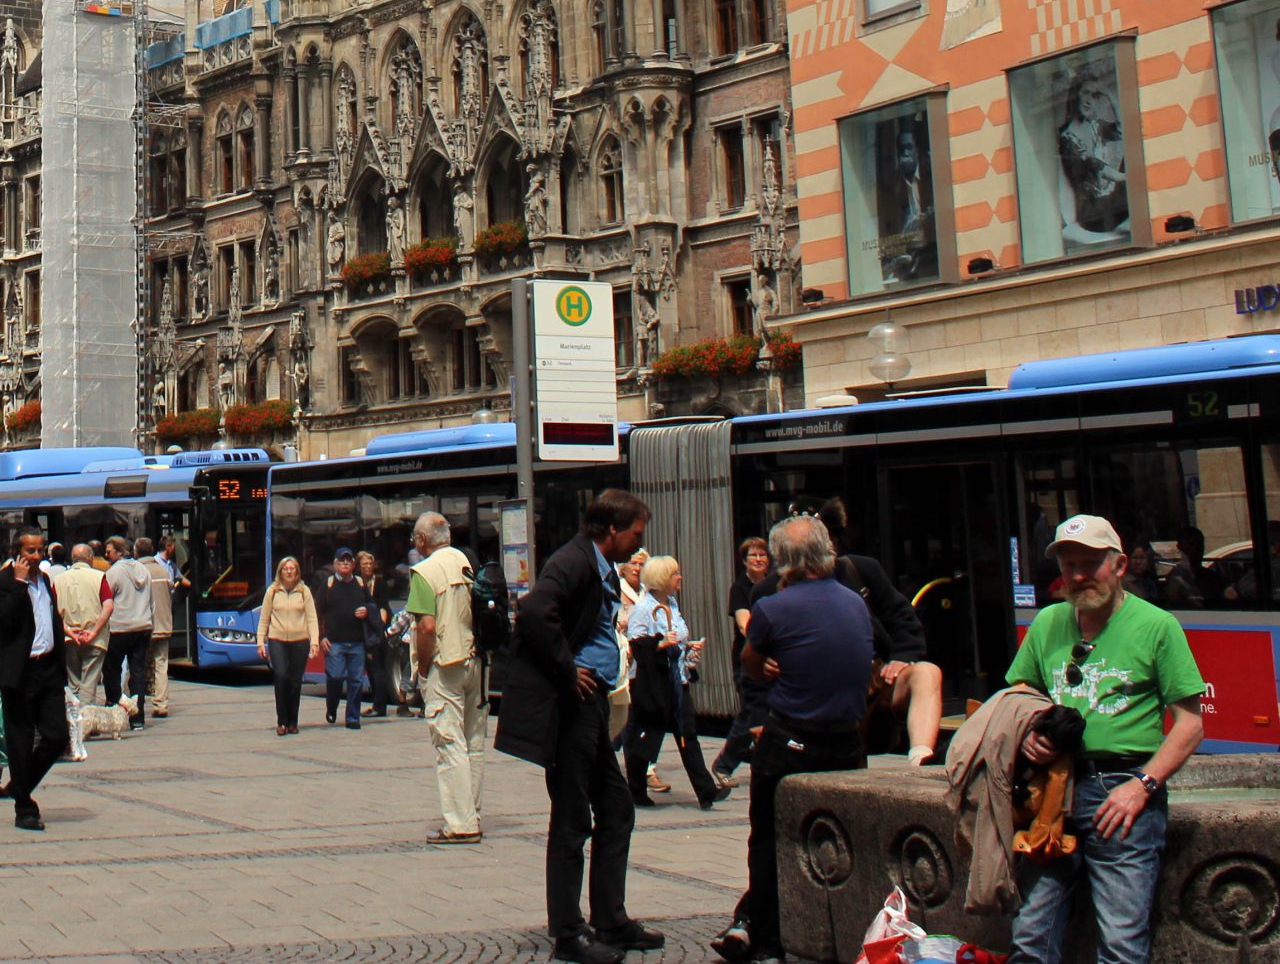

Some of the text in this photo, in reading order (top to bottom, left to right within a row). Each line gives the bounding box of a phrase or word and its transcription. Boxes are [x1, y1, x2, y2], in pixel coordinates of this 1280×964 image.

[1234, 284, 1280, 314] LUD
[1188, 391, 1219, 417] 52
[766, 421, 843, 438] www.mvg-mobil.de
[219, 480, 240, 498] 52
